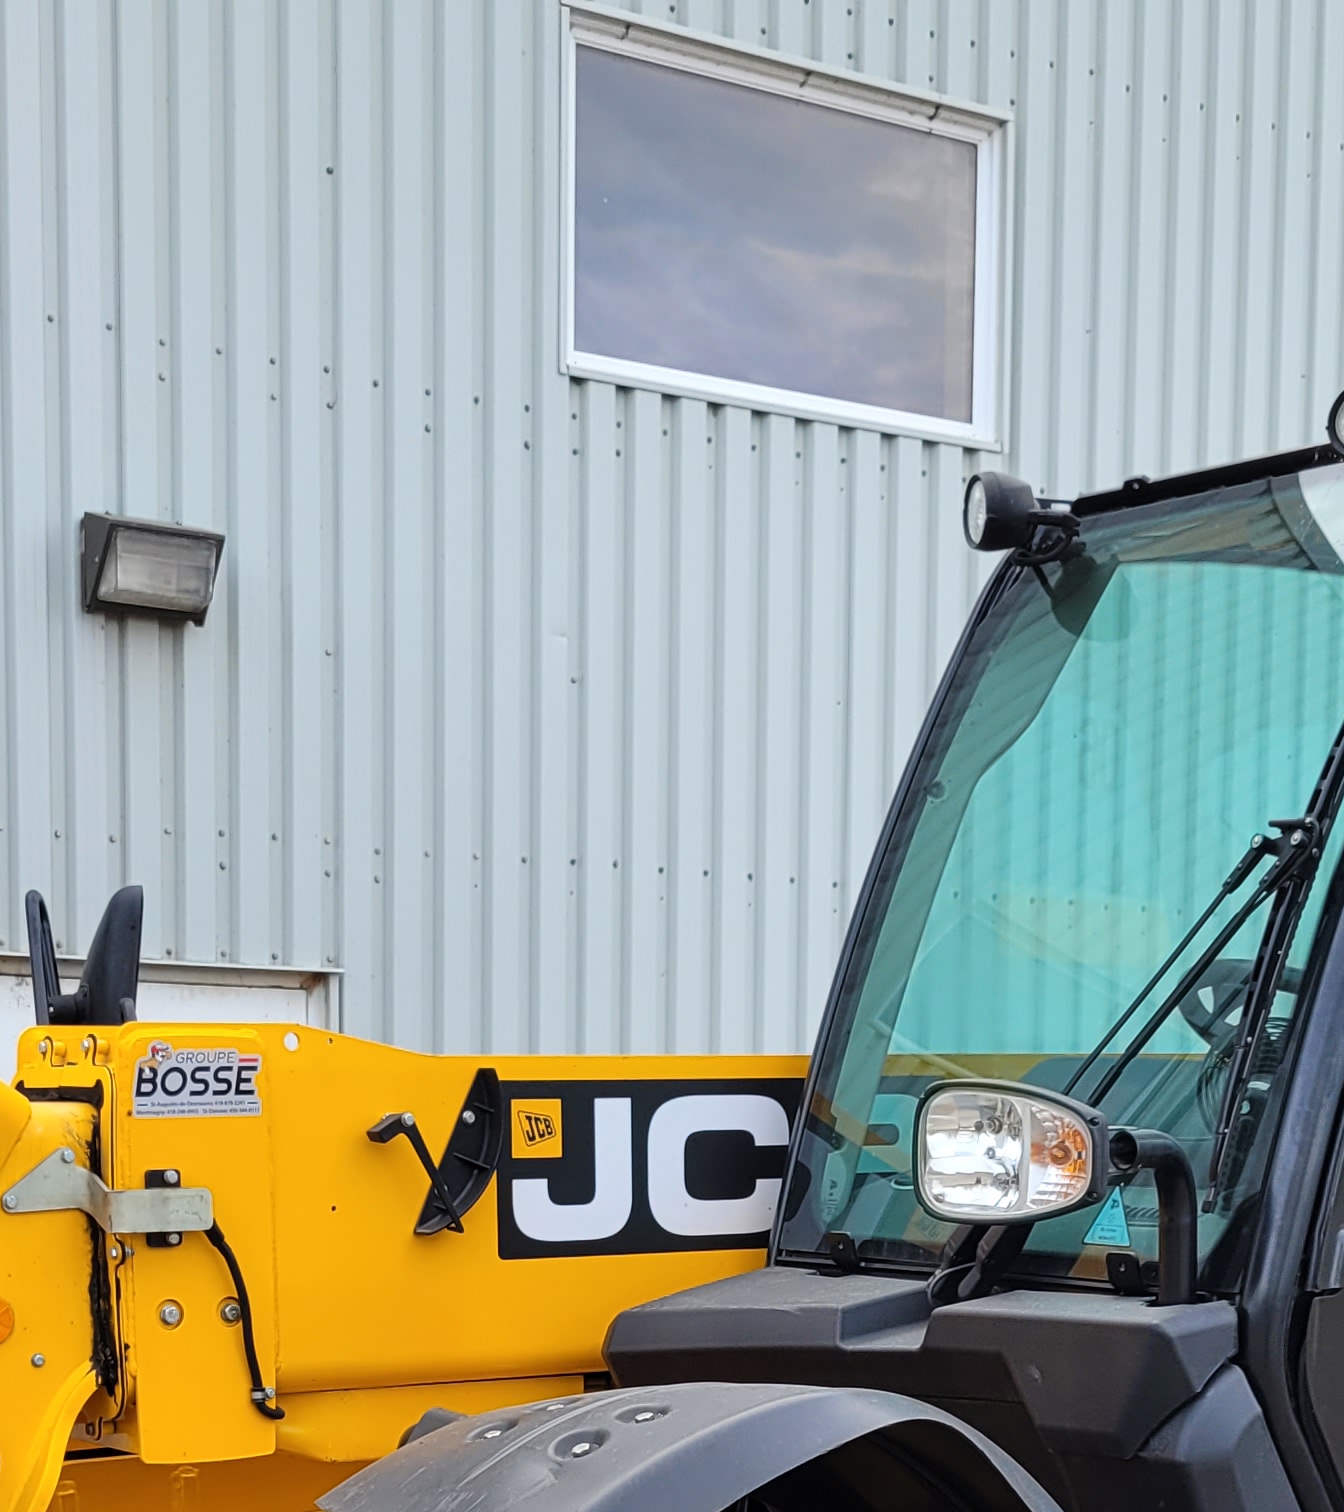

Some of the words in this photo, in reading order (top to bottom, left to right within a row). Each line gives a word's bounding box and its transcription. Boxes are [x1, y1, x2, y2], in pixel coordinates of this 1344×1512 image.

[175, 1051, 236, 1064] GROUPE
[135, 1065, 258, 1098] BOSSE
[524, 1114, 554, 1143] JCB
[512, 1094, 790, 1242] JC
